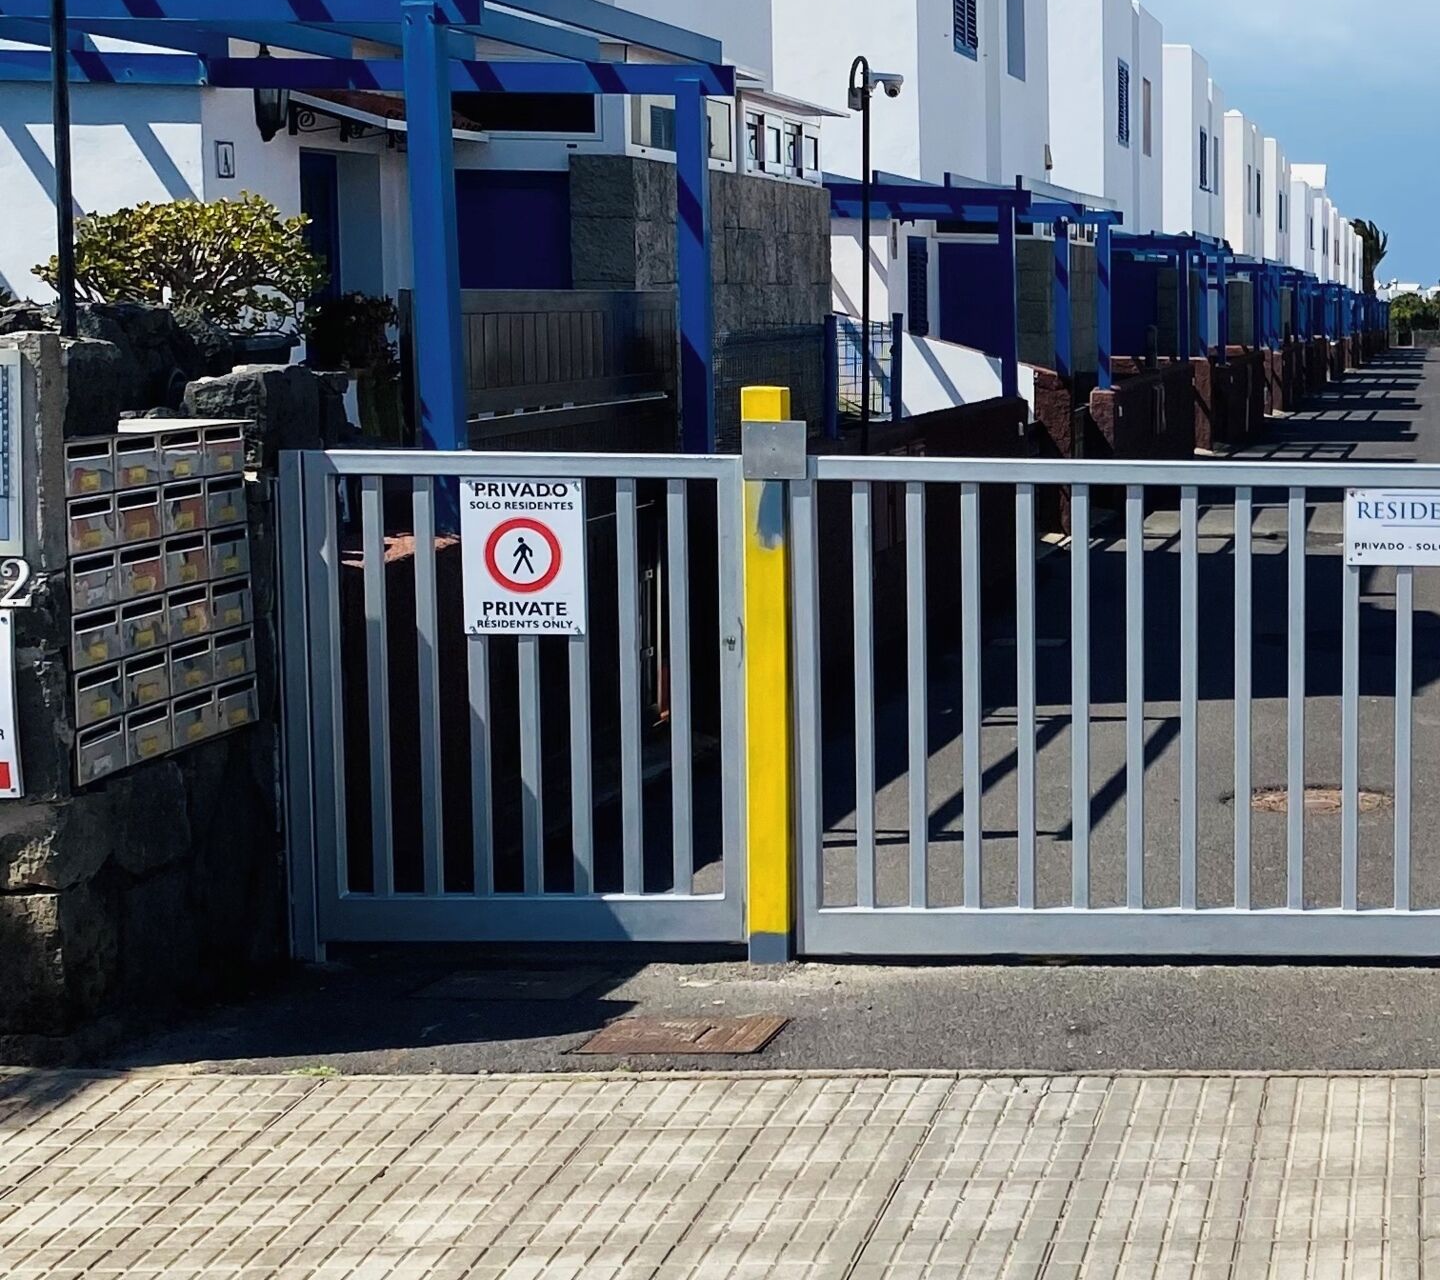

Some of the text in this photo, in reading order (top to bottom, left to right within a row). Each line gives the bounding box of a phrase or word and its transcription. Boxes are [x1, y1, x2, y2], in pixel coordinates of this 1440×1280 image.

[474, 482, 568, 498] PRIVADO
[470, 501, 574, 511] SOLO RESIDENTES
[1354, 542, 1405, 551] PRIVADO
[482, 601, 567, 616] PRIVATE
[477, 619, 574, 629] RESIDENTS ONLY
